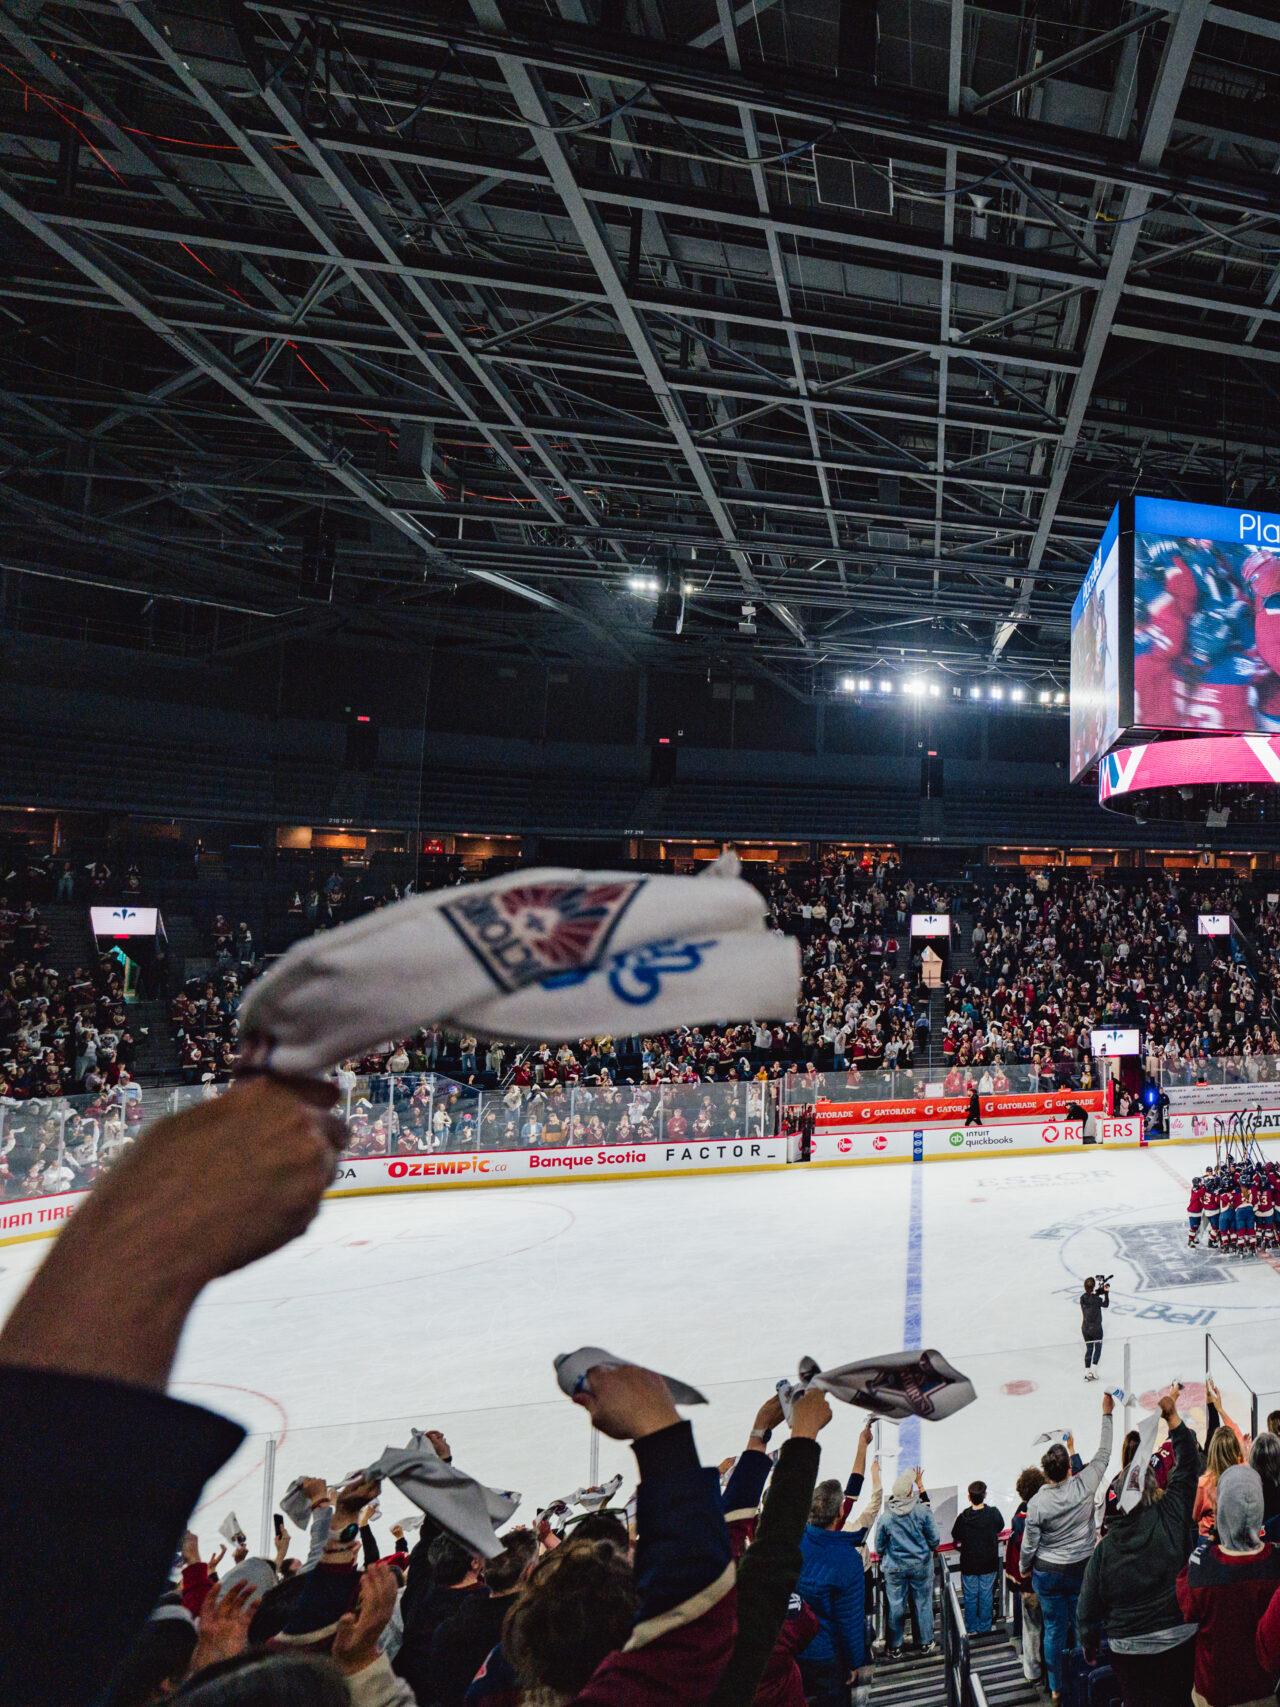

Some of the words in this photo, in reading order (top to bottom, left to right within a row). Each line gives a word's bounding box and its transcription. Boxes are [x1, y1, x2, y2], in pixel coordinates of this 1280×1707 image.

[873, 1107, 917, 1116] GATORADE
[936, 1104, 970, 1113] GATORA
[997, 1101, 1037, 1111] GATORADE
[966, 1136, 1013, 1147] quickbooks
[529, 1153, 594, 1170] Banque
[597, 1150, 646, 1166] Scotia
[0, 1212, 32, 1231] IAN
[36, 1204, 75, 1223] TIRE
